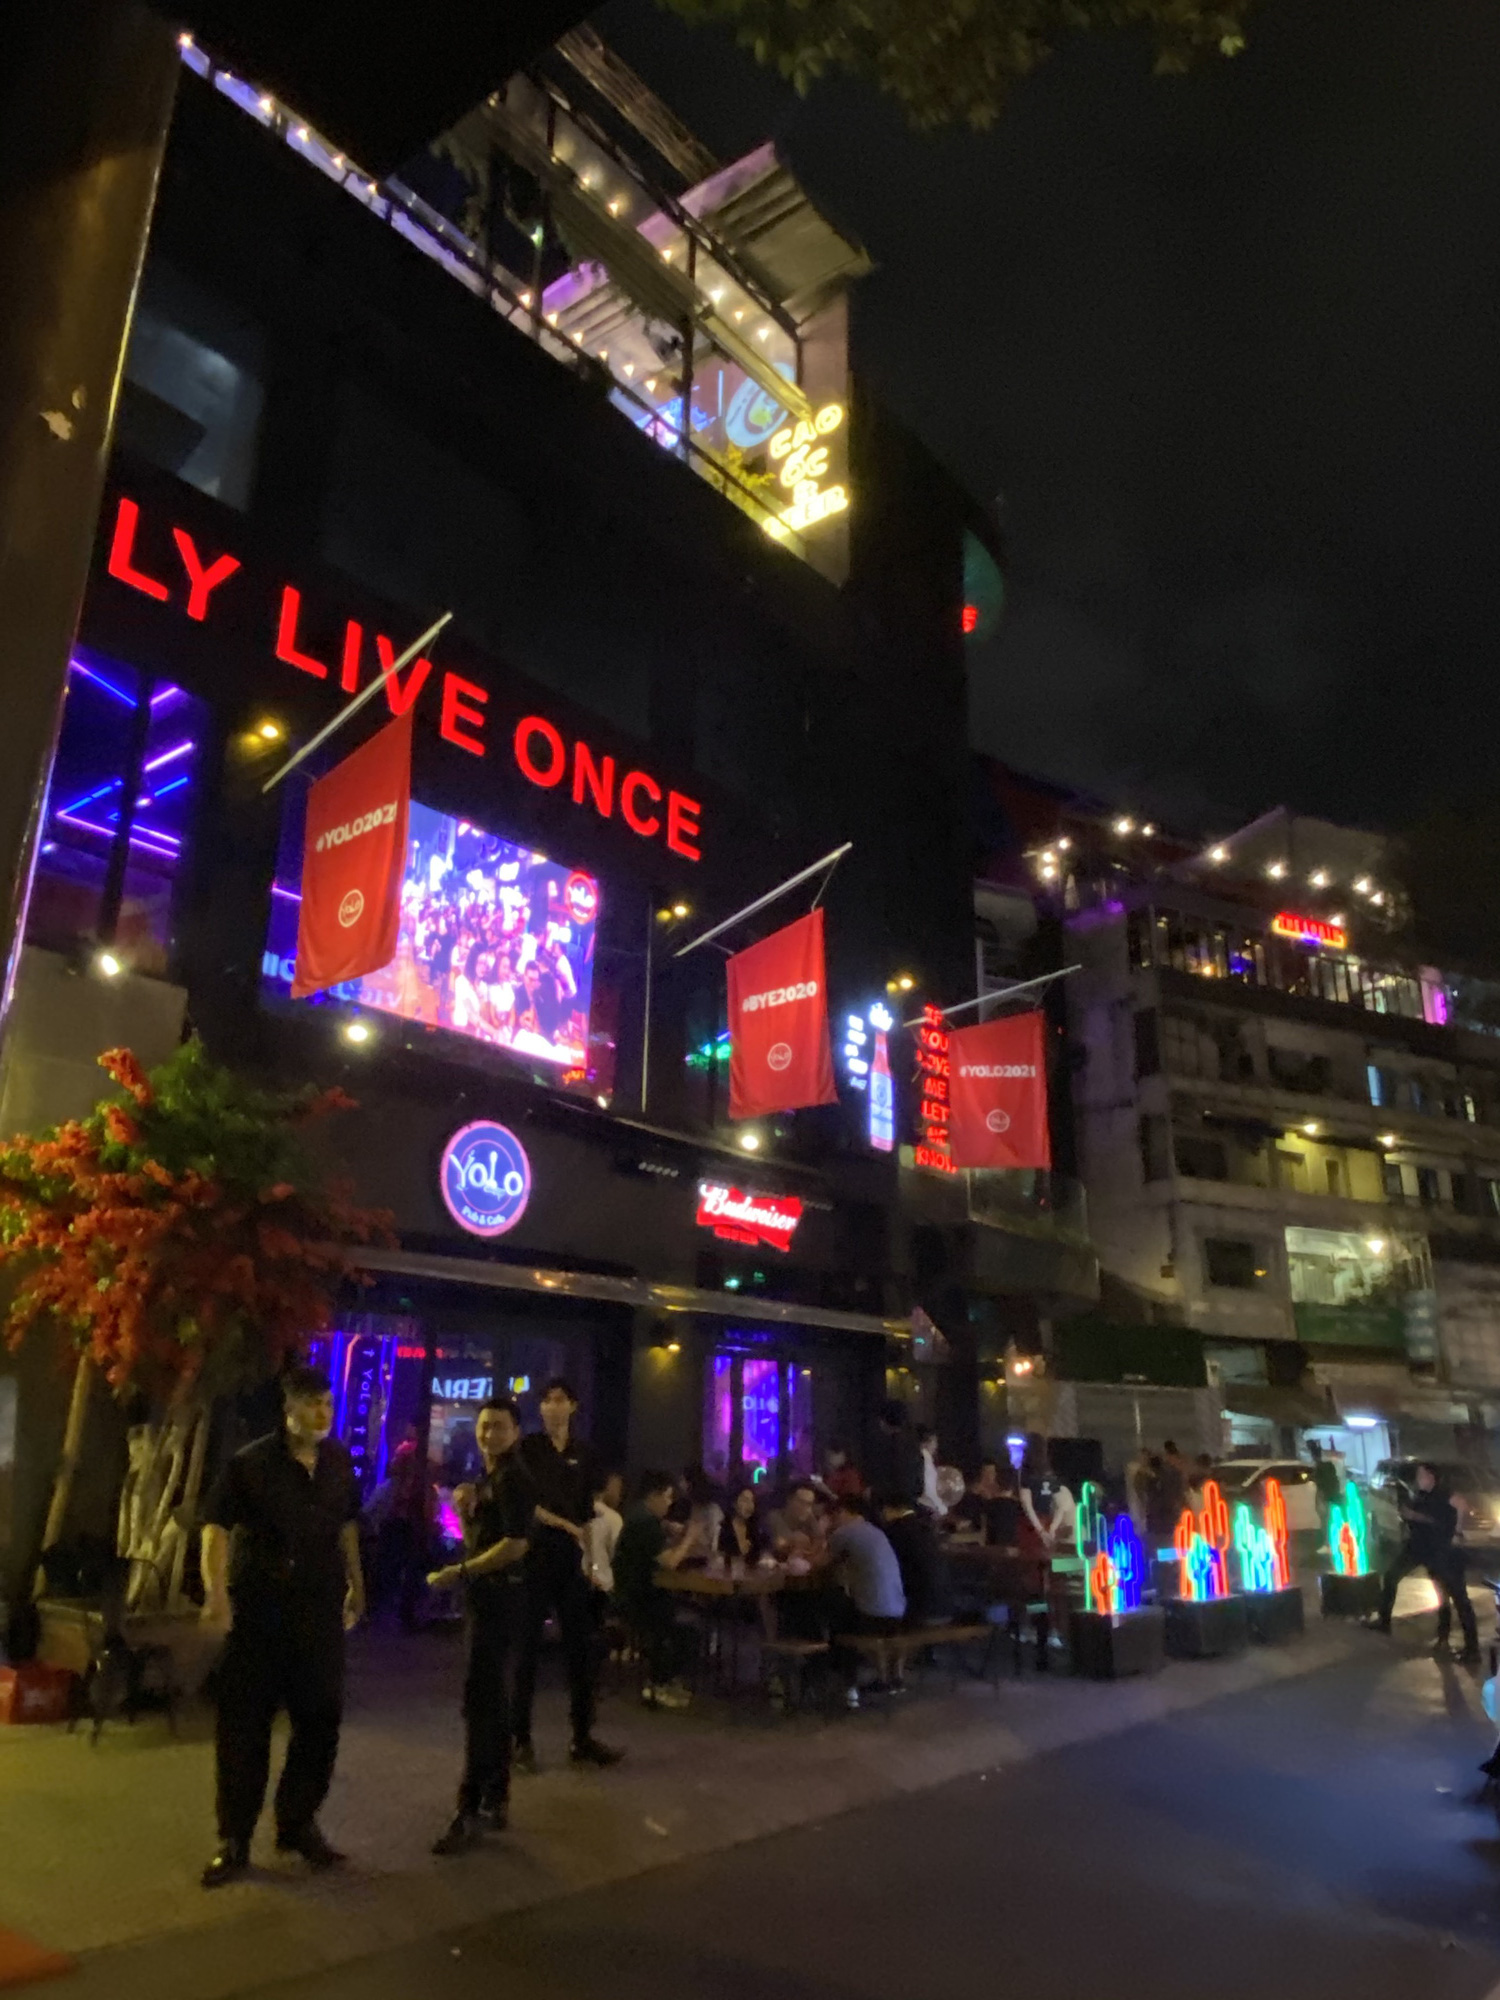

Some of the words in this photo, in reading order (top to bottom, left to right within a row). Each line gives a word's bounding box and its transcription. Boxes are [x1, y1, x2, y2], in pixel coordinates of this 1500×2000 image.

[769, 404, 843, 460] CAO
[108, 497, 241, 622] LY
[276, 585, 489, 757] LIVE
[514, 715, 702, 862] ONCE
[742, 980, 818, 1012] #BYE2020
[921, 1027, 949, 1052] YOU
[960, 1063, 1036, 1078] #YOLO2021
[924, 1077, 946, 1100] ME
[922, 1100, 949, 1123] LET
[699, 1183, 799, 1231] Budweiser
